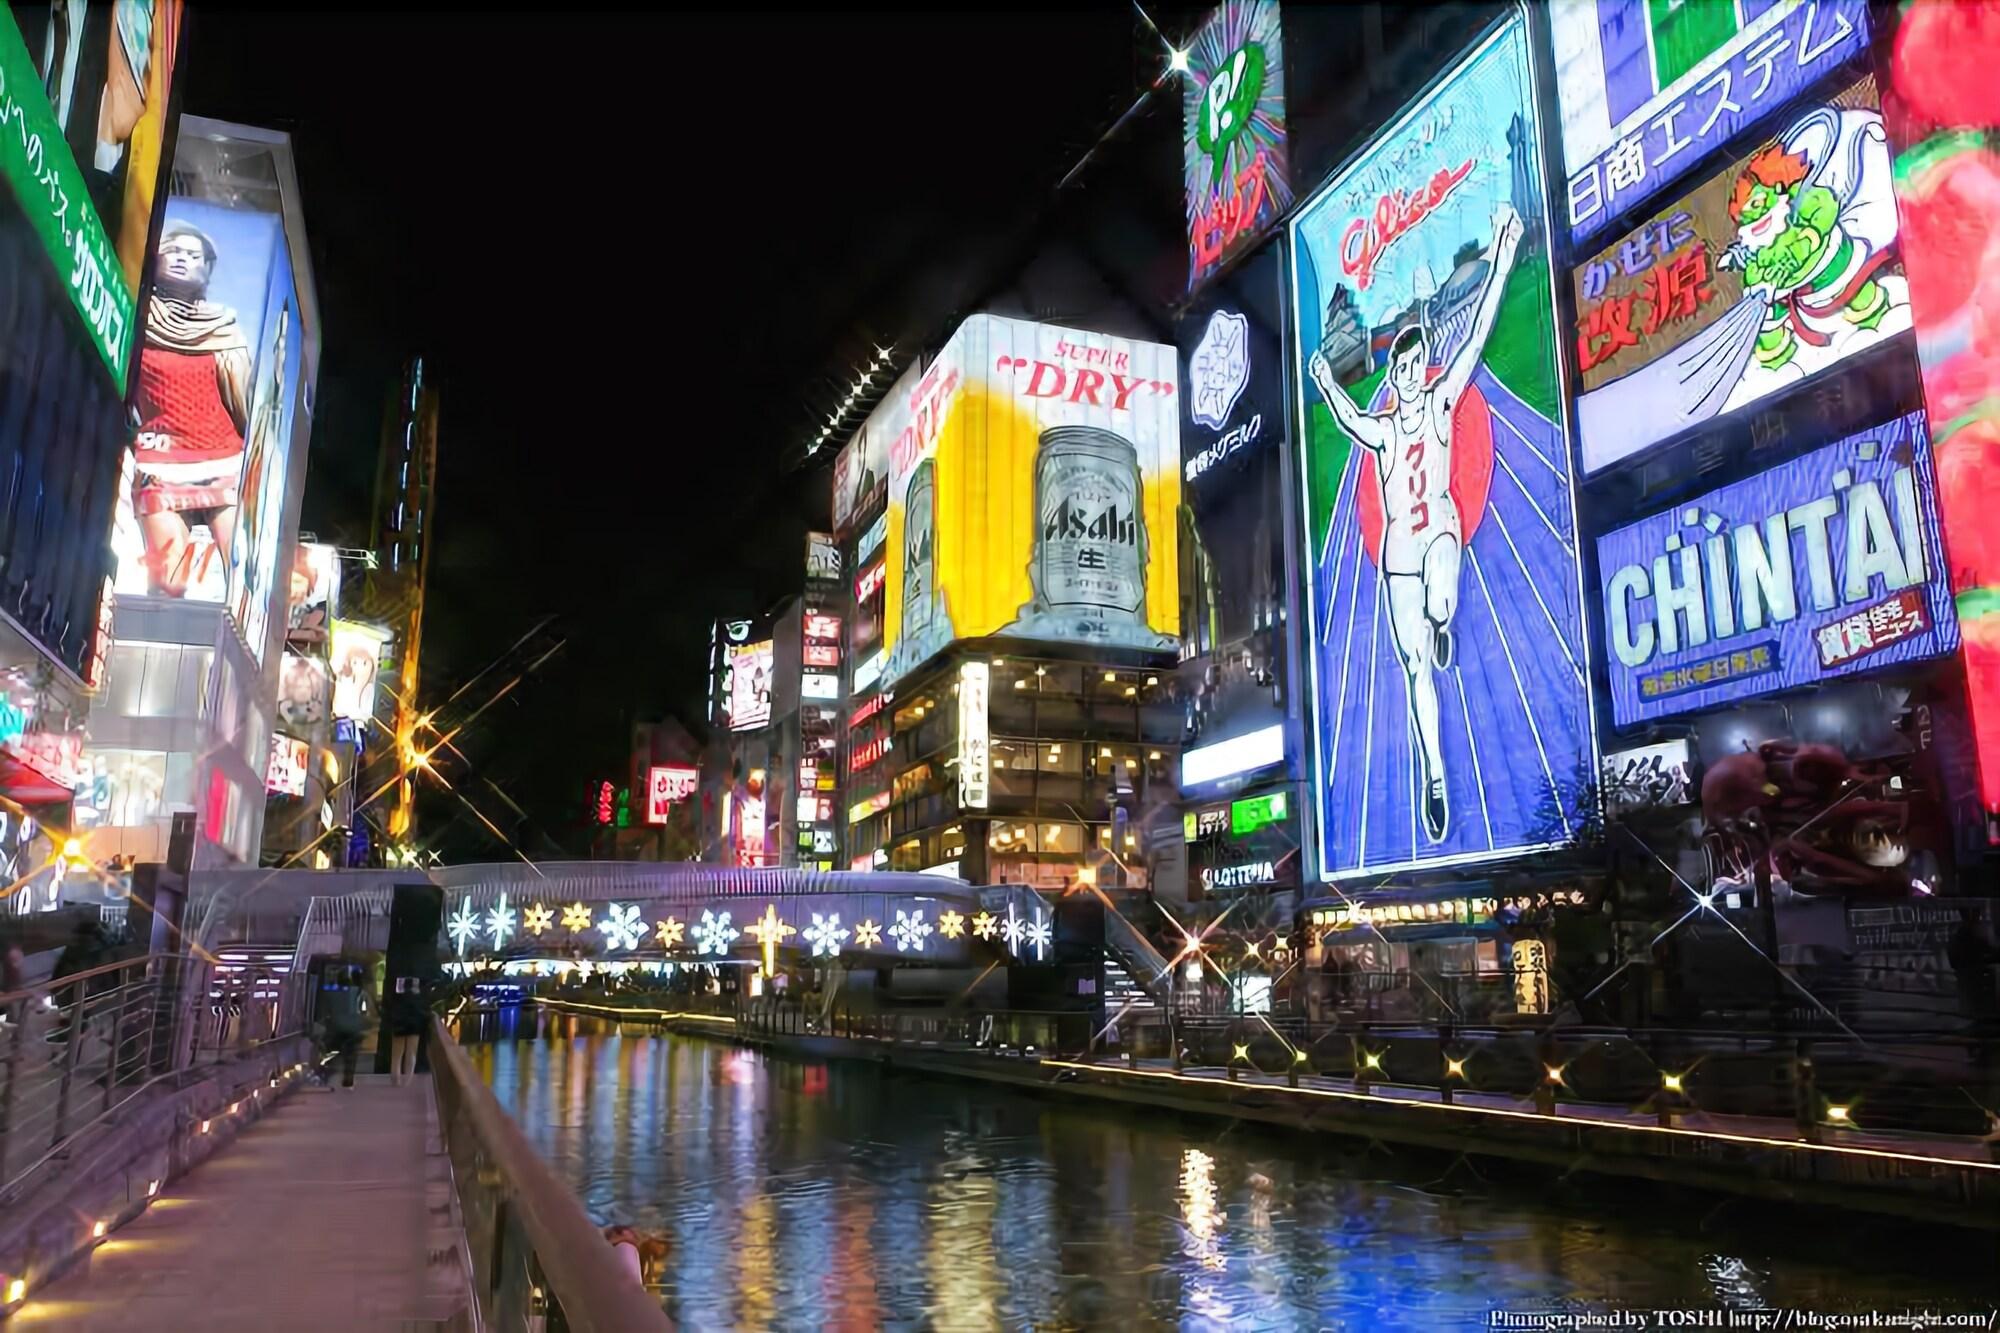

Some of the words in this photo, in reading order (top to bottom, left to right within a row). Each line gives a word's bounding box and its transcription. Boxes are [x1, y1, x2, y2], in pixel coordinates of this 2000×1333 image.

[1567, 2, 1852, 226] 日商エステム
[1055, 341, 1128, 371] SUPER
[1575, 241, 1714, 371] 改源
[1045, 496, 1135, 546] Asahi
[1405, 433, 1429, 535] グリコ
[1078, 548, 1106, 569] 生
[1606, 467, 1927, 668] CHINTAI
